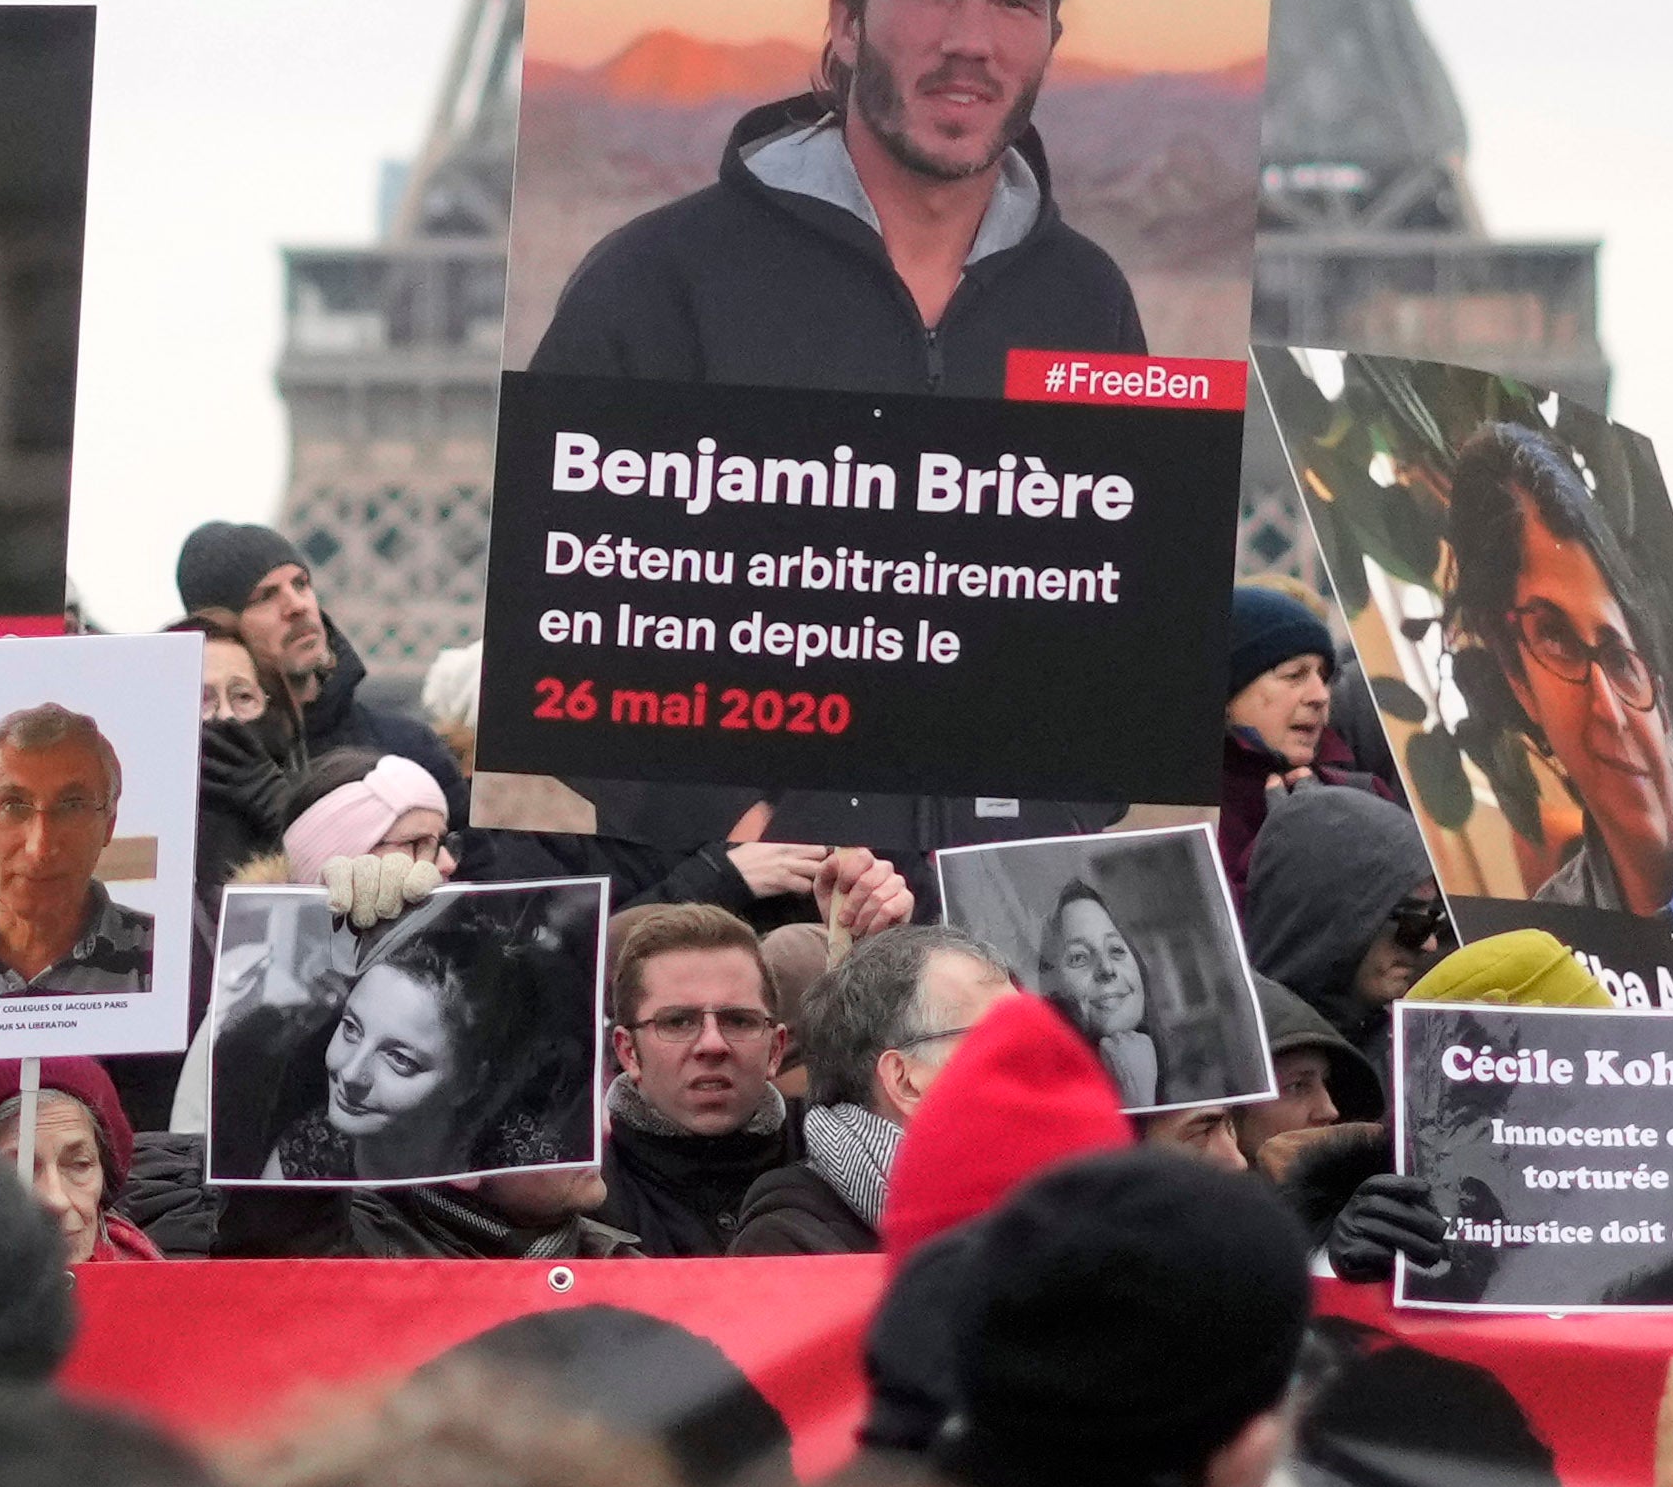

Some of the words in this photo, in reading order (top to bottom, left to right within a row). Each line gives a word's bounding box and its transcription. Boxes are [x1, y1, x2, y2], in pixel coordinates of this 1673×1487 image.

[1044, 362, 1210, 400] #FreeBen
[551, 430, 895, 514] Benjamin
[917, 452, 1135, 521] Brière
[545, 531, 734, 584] Détenu
[747, 546, 1120, 603] arbitrairement
[538, 610, 601, 646] en
[616, 603, 716, 651] Iran
[728, 610, 903, 666] depuis
[917, 620, 961, 664] le
[533, 676, 596, 721] 26
[610, 681, 707, 730] mai
[720, 687, 852, 735] 2020
[52, 1003, 63, 1011] DE
[65, 1002, 102, 1011] JACQUES
[104, 1001, 128, 1009] PARIS
[16, 1022, 26, 1030] SA
[1441, 1045, 1574, 1084] Cécile
[1491, 1119, 1658, 1147] Innocente
[1522, 1164, 1669, 1190] torturée
[1601, 1220, 1665, 1244] doit
